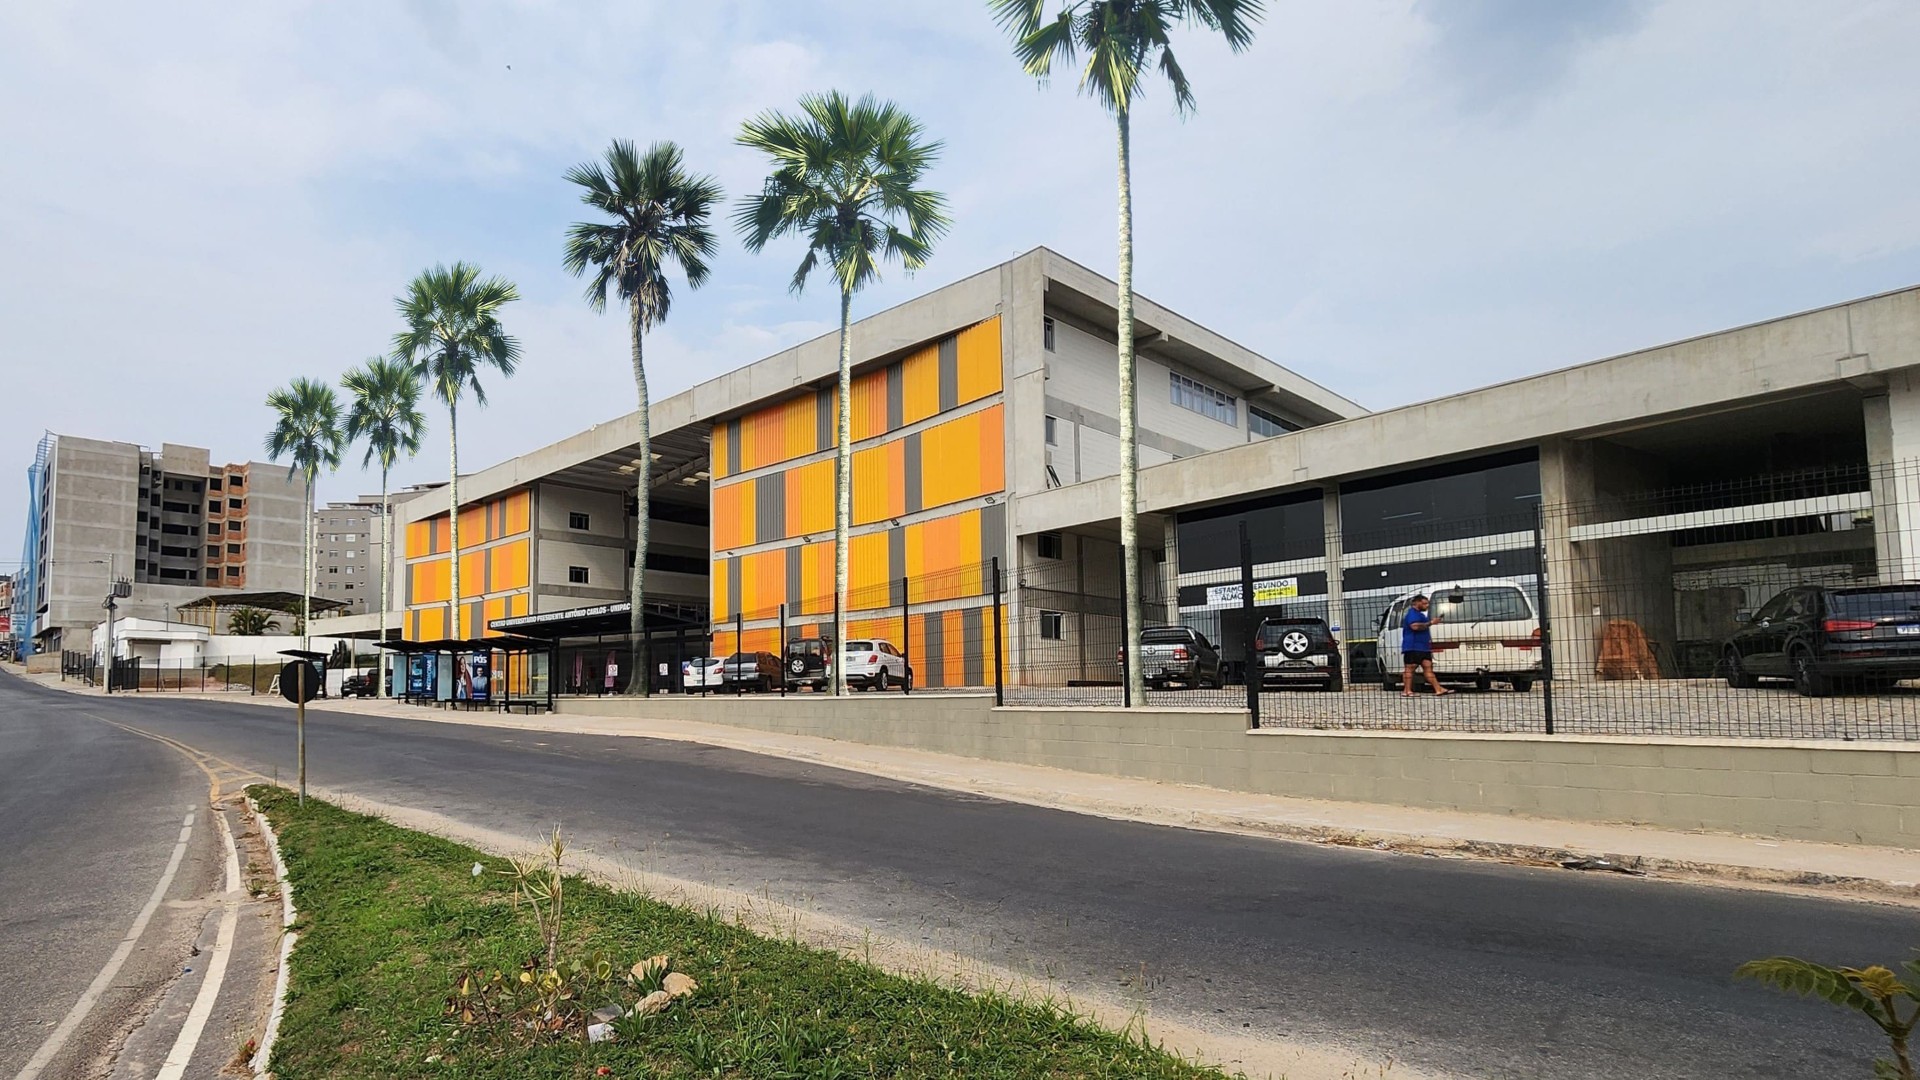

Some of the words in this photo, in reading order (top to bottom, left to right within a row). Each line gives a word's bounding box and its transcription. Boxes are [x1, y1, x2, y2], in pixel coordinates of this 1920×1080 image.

[1215, 585, 1243, 594] ESTAMO
[1253, 580, 1288, 590] ERVINDO
[586, 606, 607, 616] CARLOS
[610, 602, 631, 613] UNIPAC
[473, 654, 488, 664] PÓS
